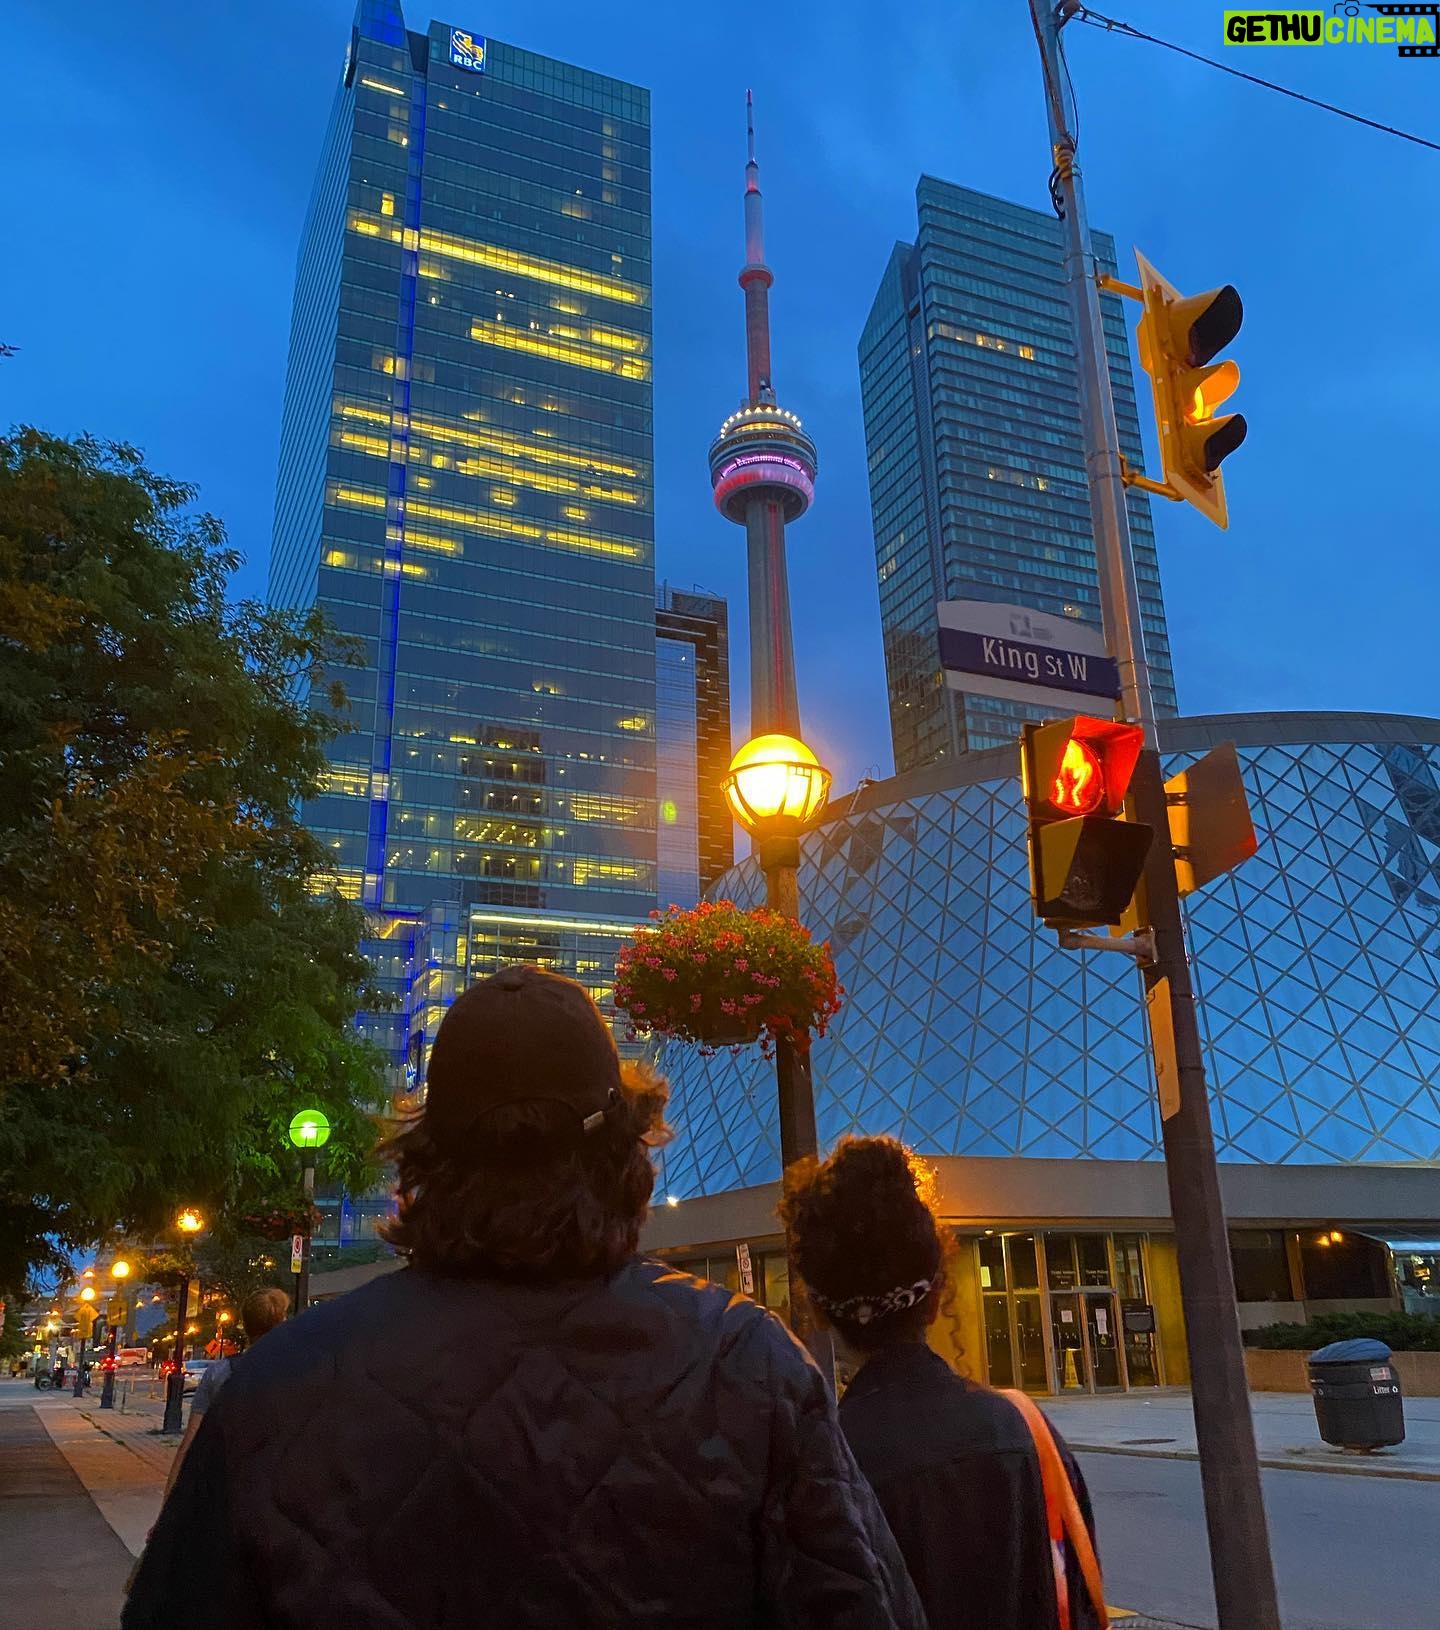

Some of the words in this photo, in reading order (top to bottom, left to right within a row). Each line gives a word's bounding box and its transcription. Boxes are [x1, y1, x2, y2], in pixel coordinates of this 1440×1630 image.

[453, 54, 482, 71] RBC
[982, 637, 1039, 679] King
[1045, 655, 1065, 678] St
[1068, 653, 1088, 682] W
